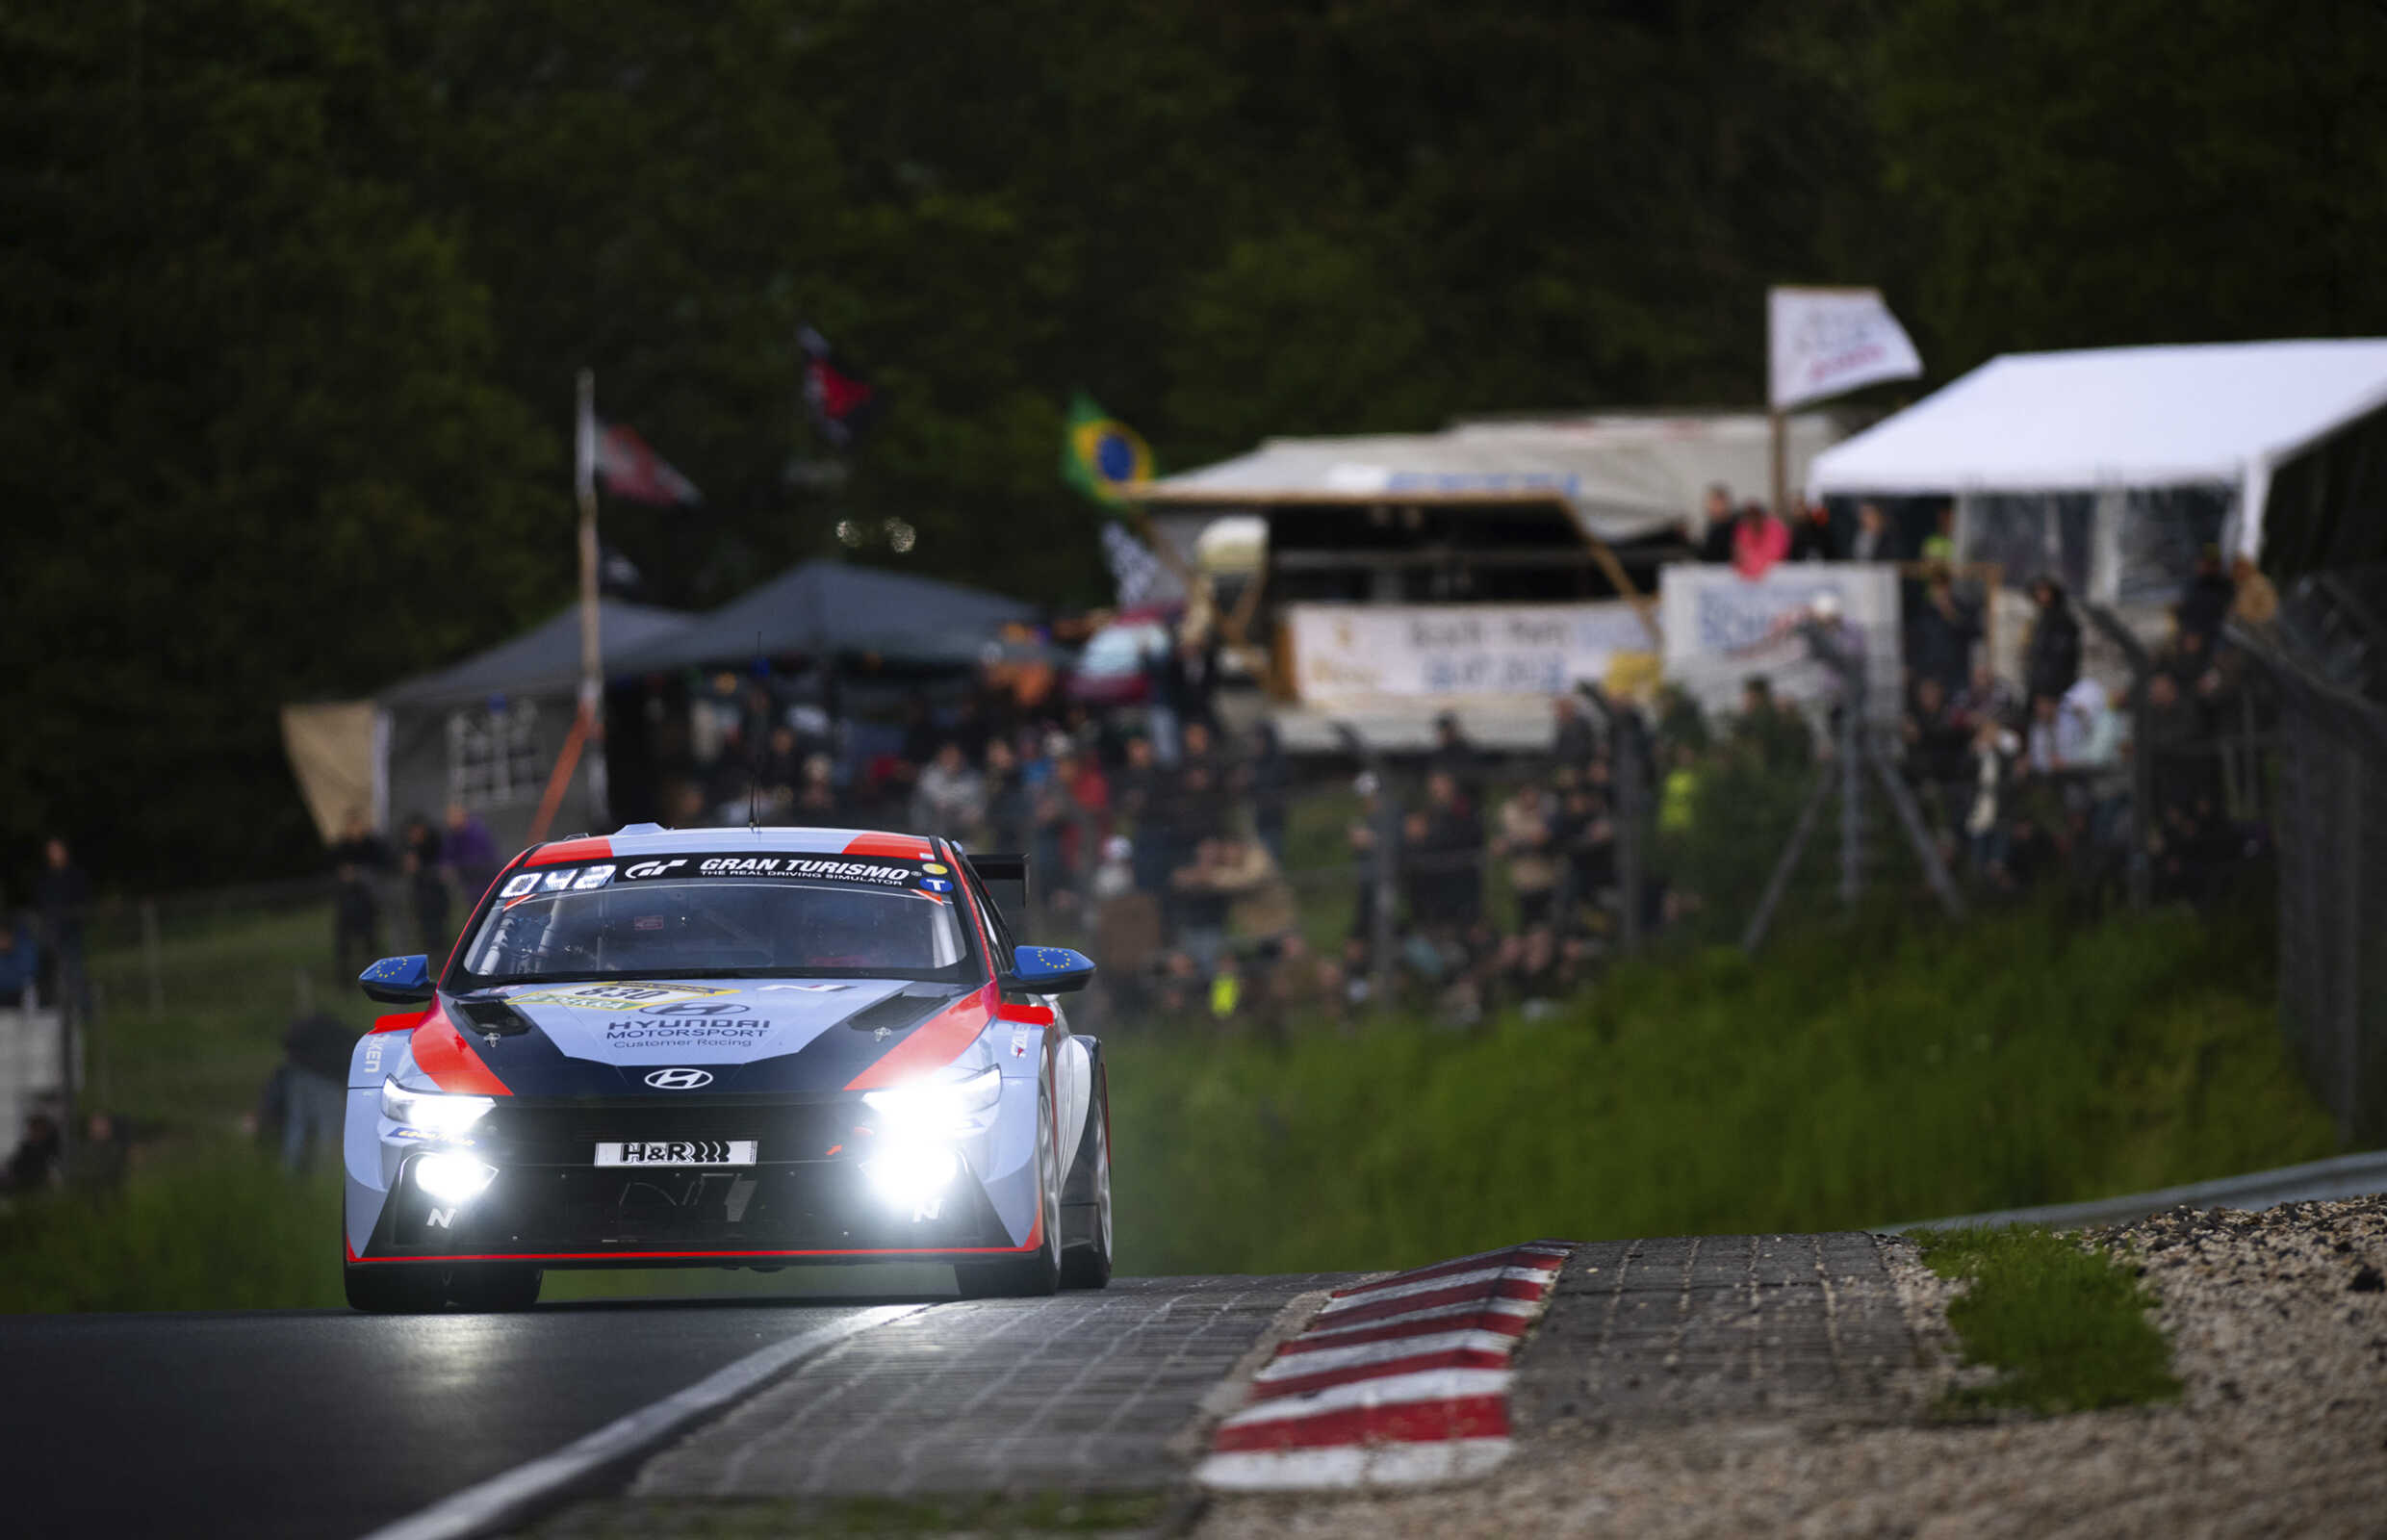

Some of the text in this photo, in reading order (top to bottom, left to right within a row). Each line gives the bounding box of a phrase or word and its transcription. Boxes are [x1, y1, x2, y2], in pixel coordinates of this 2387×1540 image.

[700, 858, 910, 880] GRAN TURISMO
[499, 864, 617, 898] 042
[825, 873, 903, 886] SIMULATOR
[925, 879, 946, 891] T
[574, 987, 670, 1000] 830
[607, 1019, 771, 1031] HYUNDAI
[606, 1029, 770, 1040] MOTORSPORT
[613, 1039, 752, 1049] Customer Racing
[426, 1208, 456, 1229] N
